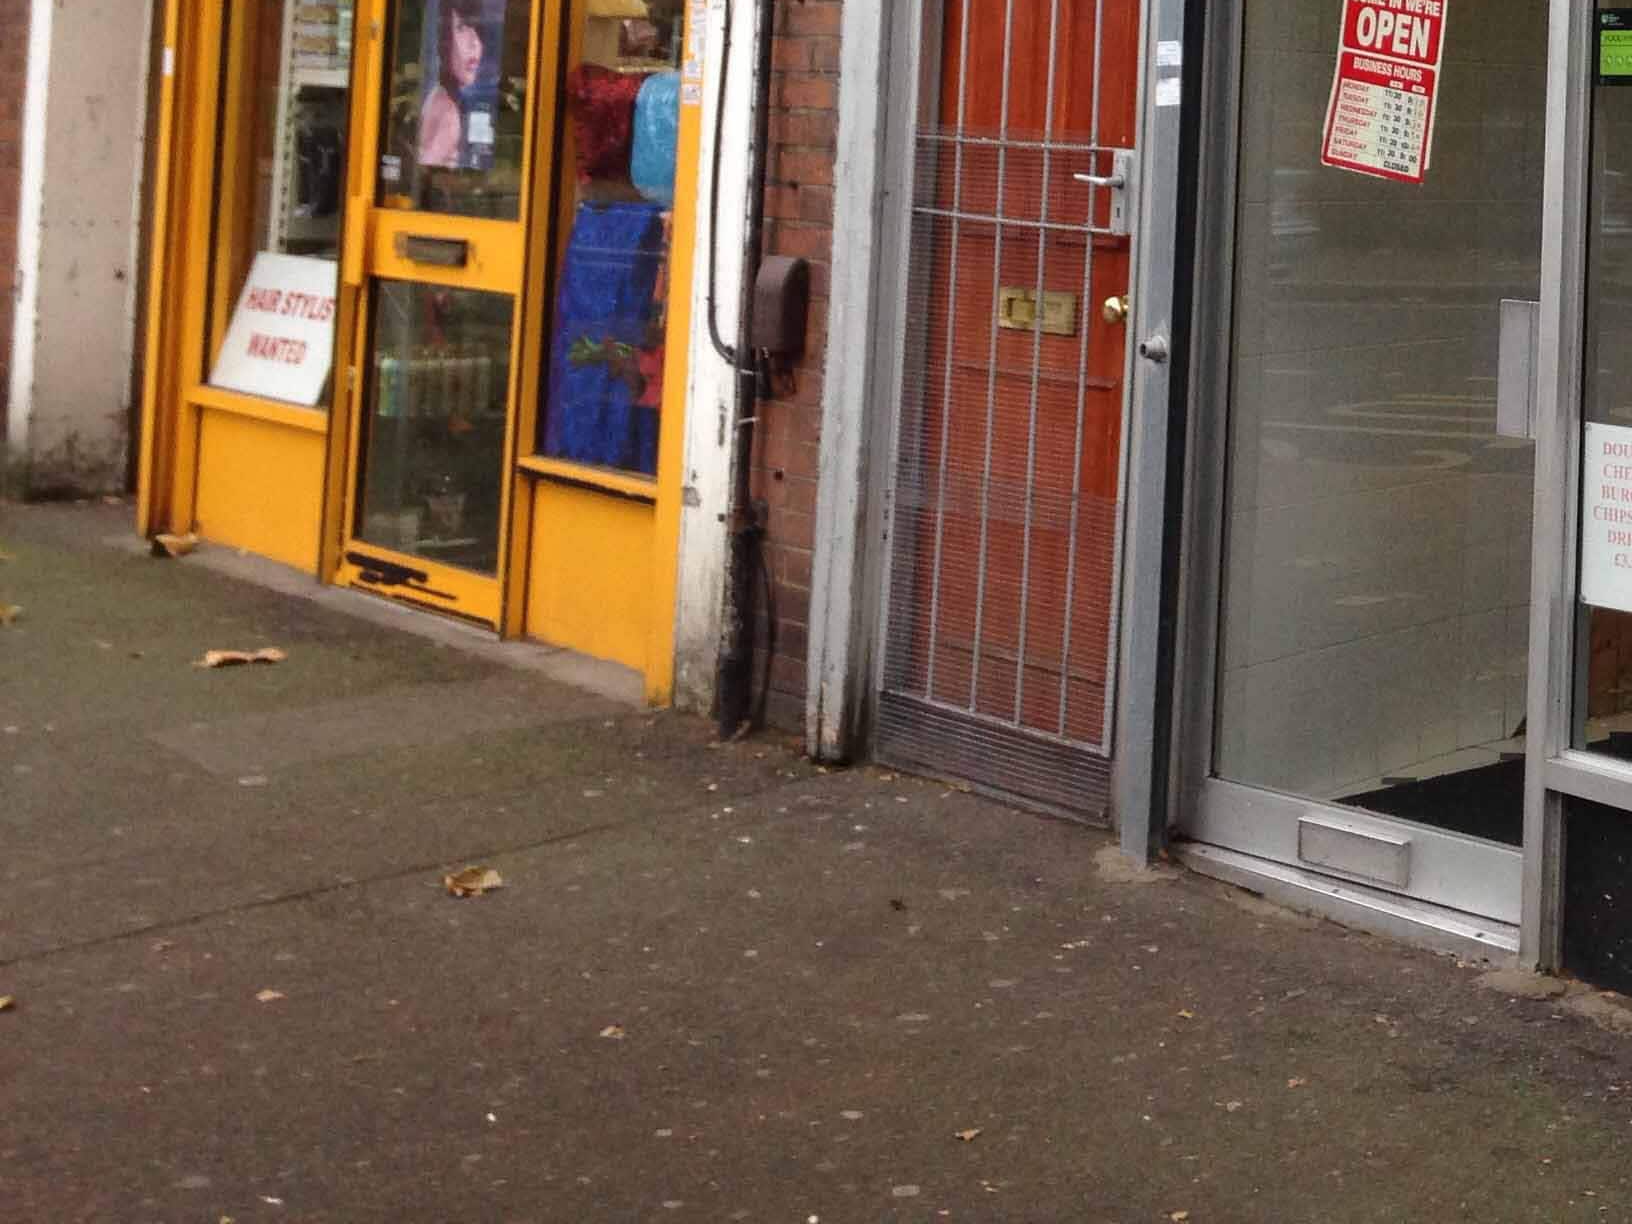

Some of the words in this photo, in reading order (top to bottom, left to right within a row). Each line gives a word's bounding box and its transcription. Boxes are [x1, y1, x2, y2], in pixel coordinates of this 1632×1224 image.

[1356, 6, 1431, 59] OPEN
[1353, 57, 1393, 77] BUSINESS
[1393, 65, 1423, 83] HOURS
[281, 290, 337, 322] STYLIS
[247, 332, 308, 365] WANTED
